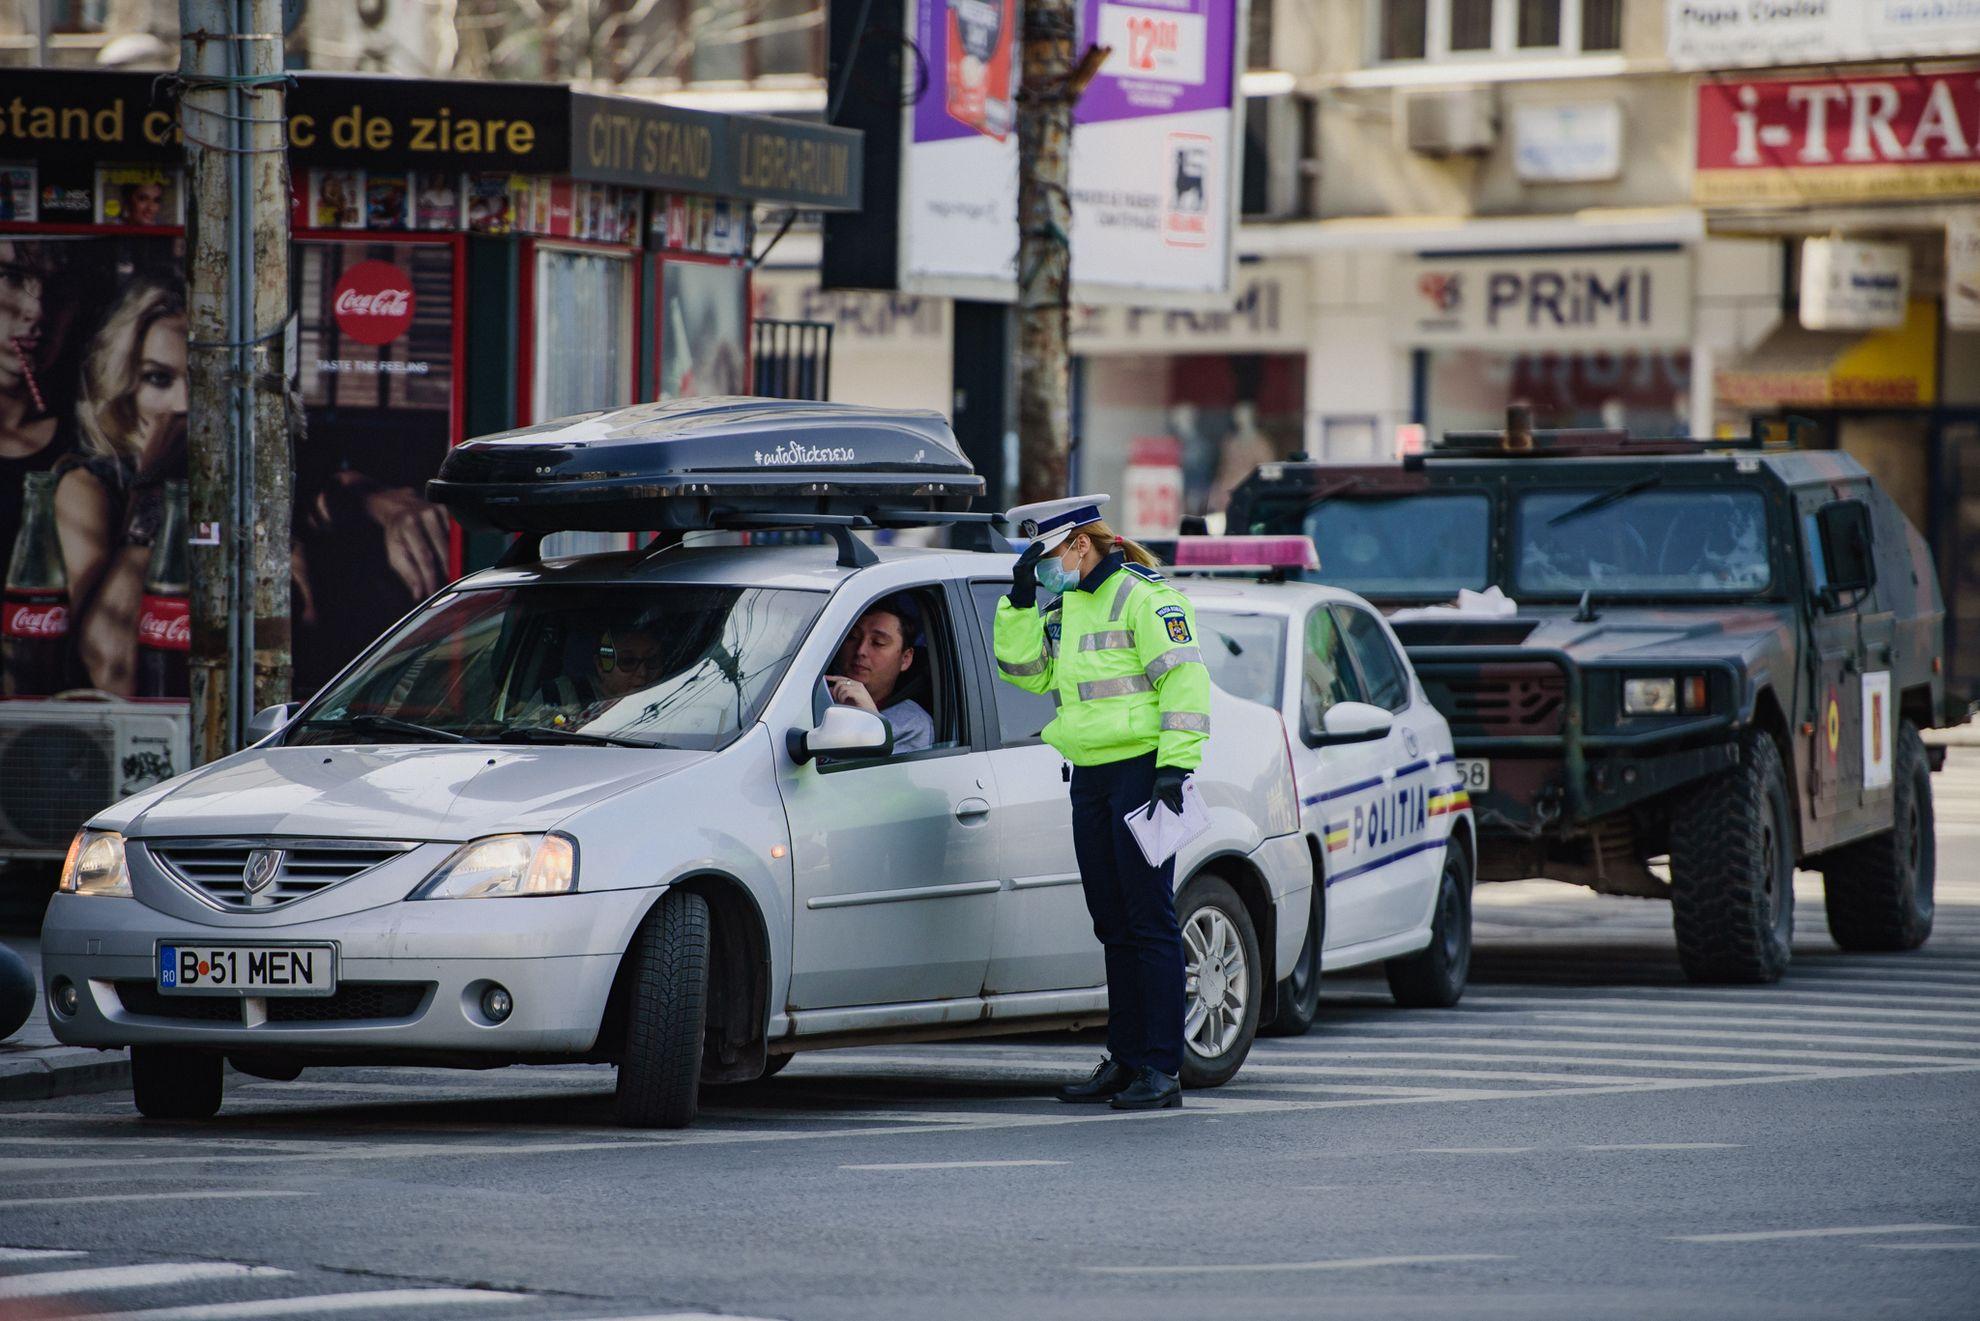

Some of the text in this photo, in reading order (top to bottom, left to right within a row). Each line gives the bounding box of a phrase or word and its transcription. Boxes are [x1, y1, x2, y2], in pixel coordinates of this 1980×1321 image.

[0, 96, 124, 142] tand
[331, 104, 394, 150] de
[409, 106, 536, 155] ziare
[1734, 80, 1980, 166] i-TRA
[588, 112, 712, 181] CITY STAND
[335, 288, 410, 317] Coca-Cola
[316, 360, 430, 375] TASTE THE FEELING
[139, 611, 190, 641] Coca-Co
[162, 969, 176, 983] RO
[180, 951, 313, 984] B 51 MEN
